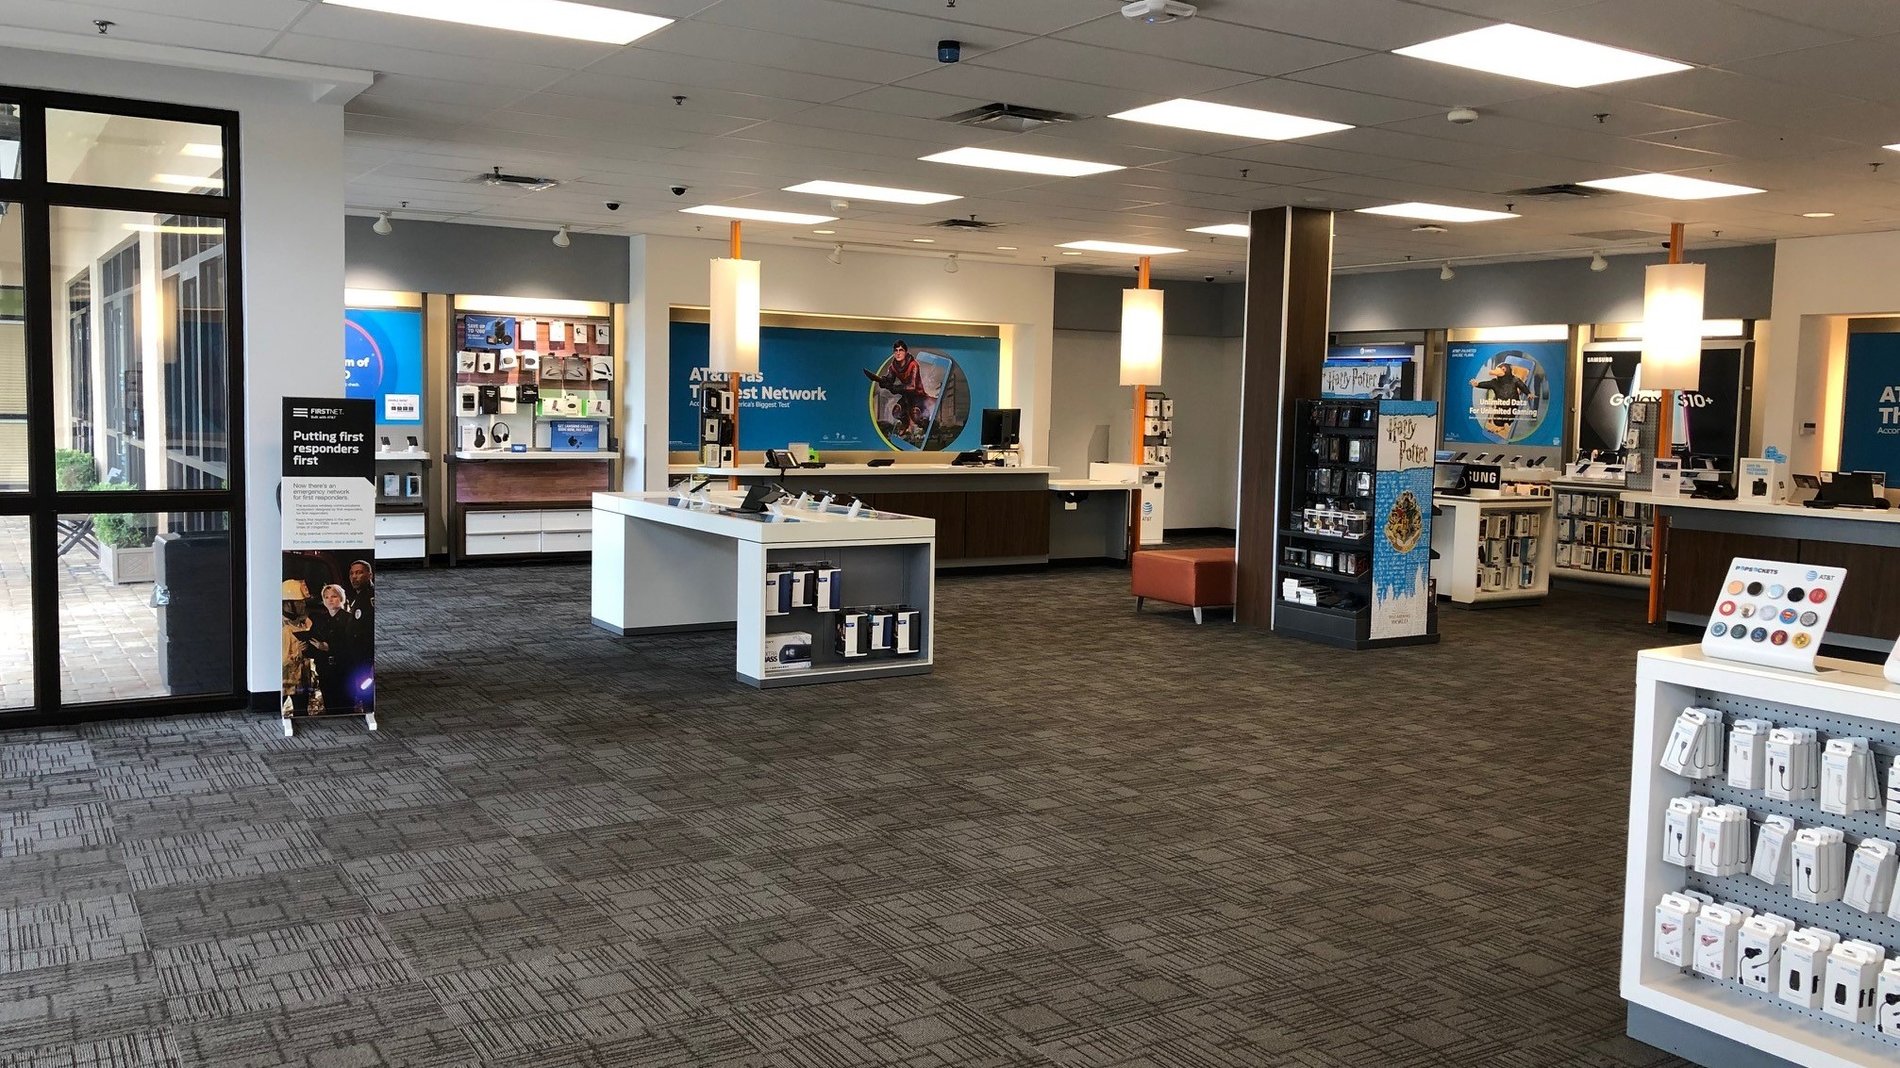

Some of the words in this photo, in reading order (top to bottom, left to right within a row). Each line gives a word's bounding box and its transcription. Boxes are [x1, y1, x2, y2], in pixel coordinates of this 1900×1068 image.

[357, 357, 369, 367] of
[1328, 370, 1351, 391] Harry
[1352, 368, 1377, 393] Potter
[738, 386, 758, 399] est
[762, 386, 827, 401] Network
[755, 401, 778, 409] Biggest
[1480, 398, 1510, 406] Unlimited
[1610, 393, 1662, 406] Galax
[1678, 394, 1713, 408] S10+
[1512, 408, 1538, 417] Gaming
[1386, 417, 1417, 443] Harry
[293, 430, 337, 443] Putting
[339, 431, 364, 442] first
[293, 443, 359, 455] responders
[1399, 440, 1428, 469] Potter
[293, 455, 318, 465] first
